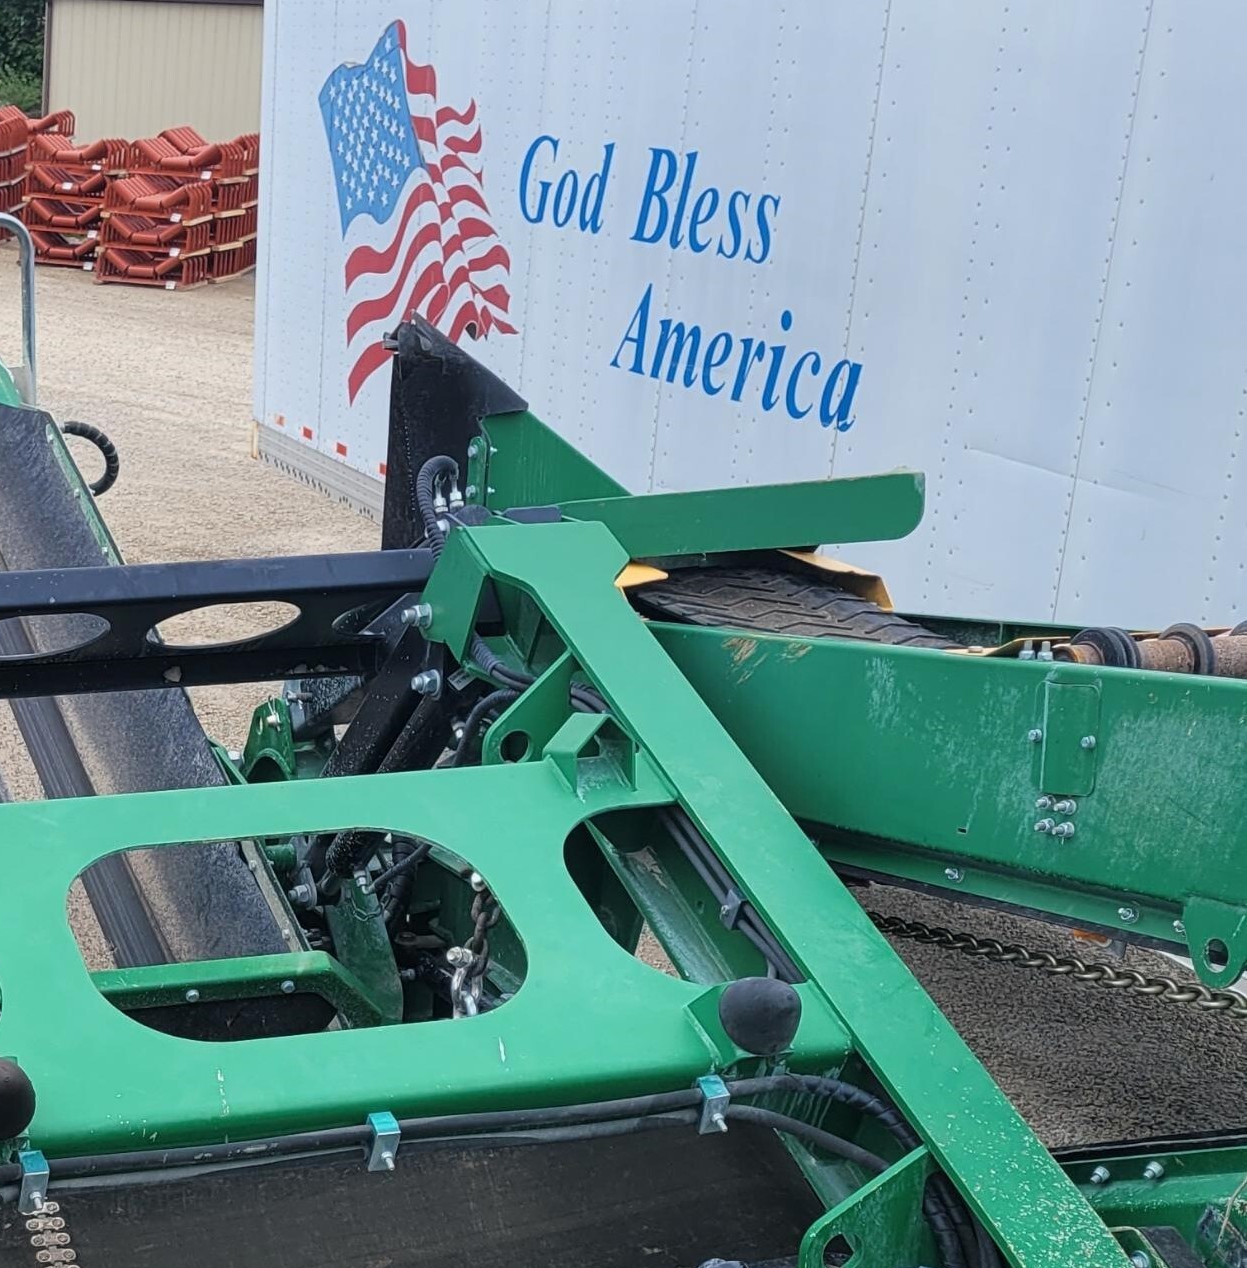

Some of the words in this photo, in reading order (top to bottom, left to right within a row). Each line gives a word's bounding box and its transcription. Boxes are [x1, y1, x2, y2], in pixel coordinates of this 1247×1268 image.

[518, 134, 615, 235] God
[630, 147, 781, 265] Bless
[610, 282, 863, 433] America
